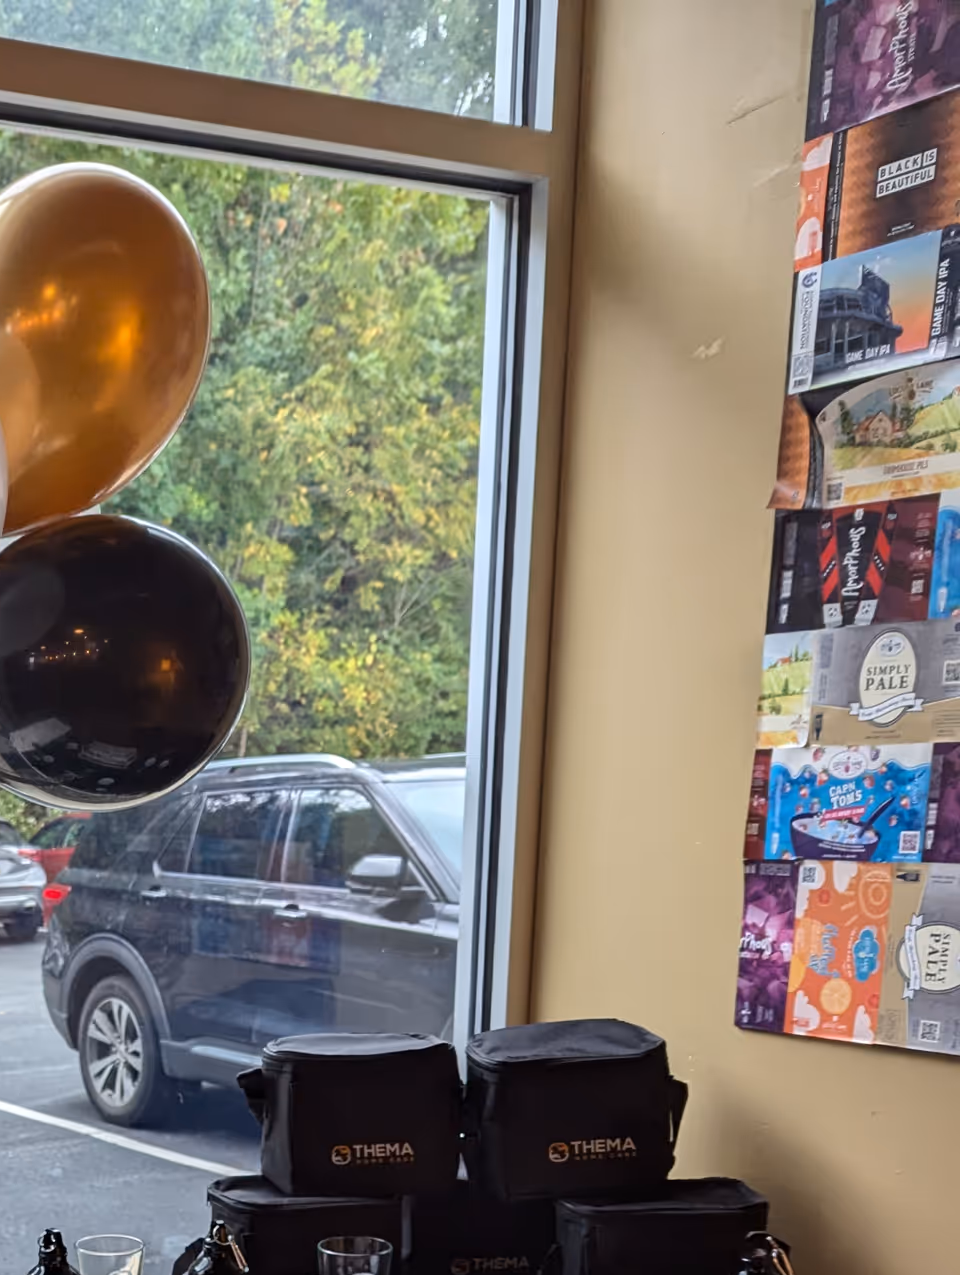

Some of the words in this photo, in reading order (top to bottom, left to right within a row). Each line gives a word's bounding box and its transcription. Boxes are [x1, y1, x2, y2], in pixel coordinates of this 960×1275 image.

[880, 156, 920, 179] BLACK
[925, 151, 936, 163] IS
[878, 168, 933, 195] BEAUTIFUL
[939, 258, 951, 279] IPA
[936, 281, 948, 304] DAY
[931, 304, 945, 336] GAME
[866, 664, 911, 677] SIMPLY
[864, 675, 909, 691] PALE
[831, 790, 863, 809] TOMS
[924, 933, 942, 982] PALE
[937, 933, 951, 984] SIMPLY
[353, 1143, 414, 1157] THEMA
[571, 1137, 637, 1152] THEMA
[473, 1256, 529, 1270] THEMA
